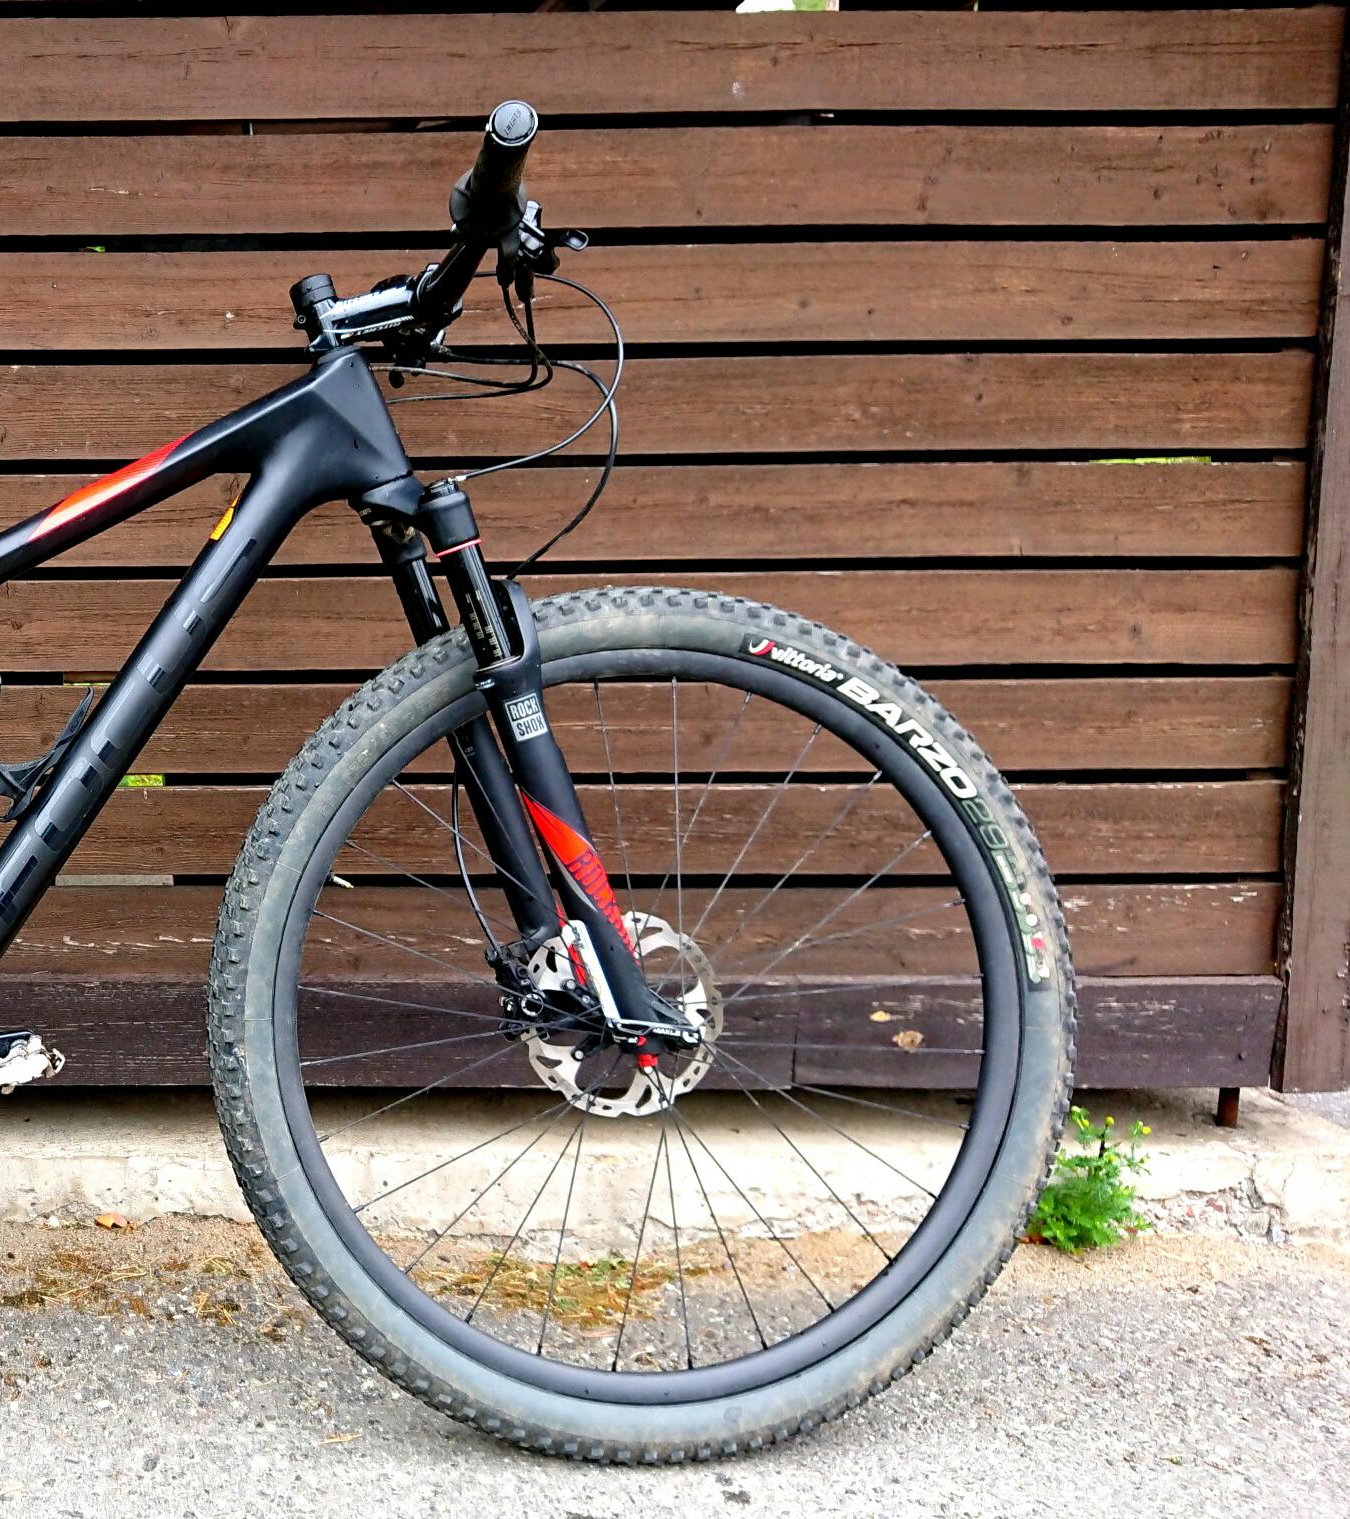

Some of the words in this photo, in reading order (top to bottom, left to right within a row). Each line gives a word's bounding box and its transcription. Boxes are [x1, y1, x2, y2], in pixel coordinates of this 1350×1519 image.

[508, 696, 539, 720] ROCK
[516, 714, 545, 737] SHOX
[770, 645, 837, 683] vittoria
[837, 677, 978, 800] BARZO
[962, 800, 1009, 849] 29
